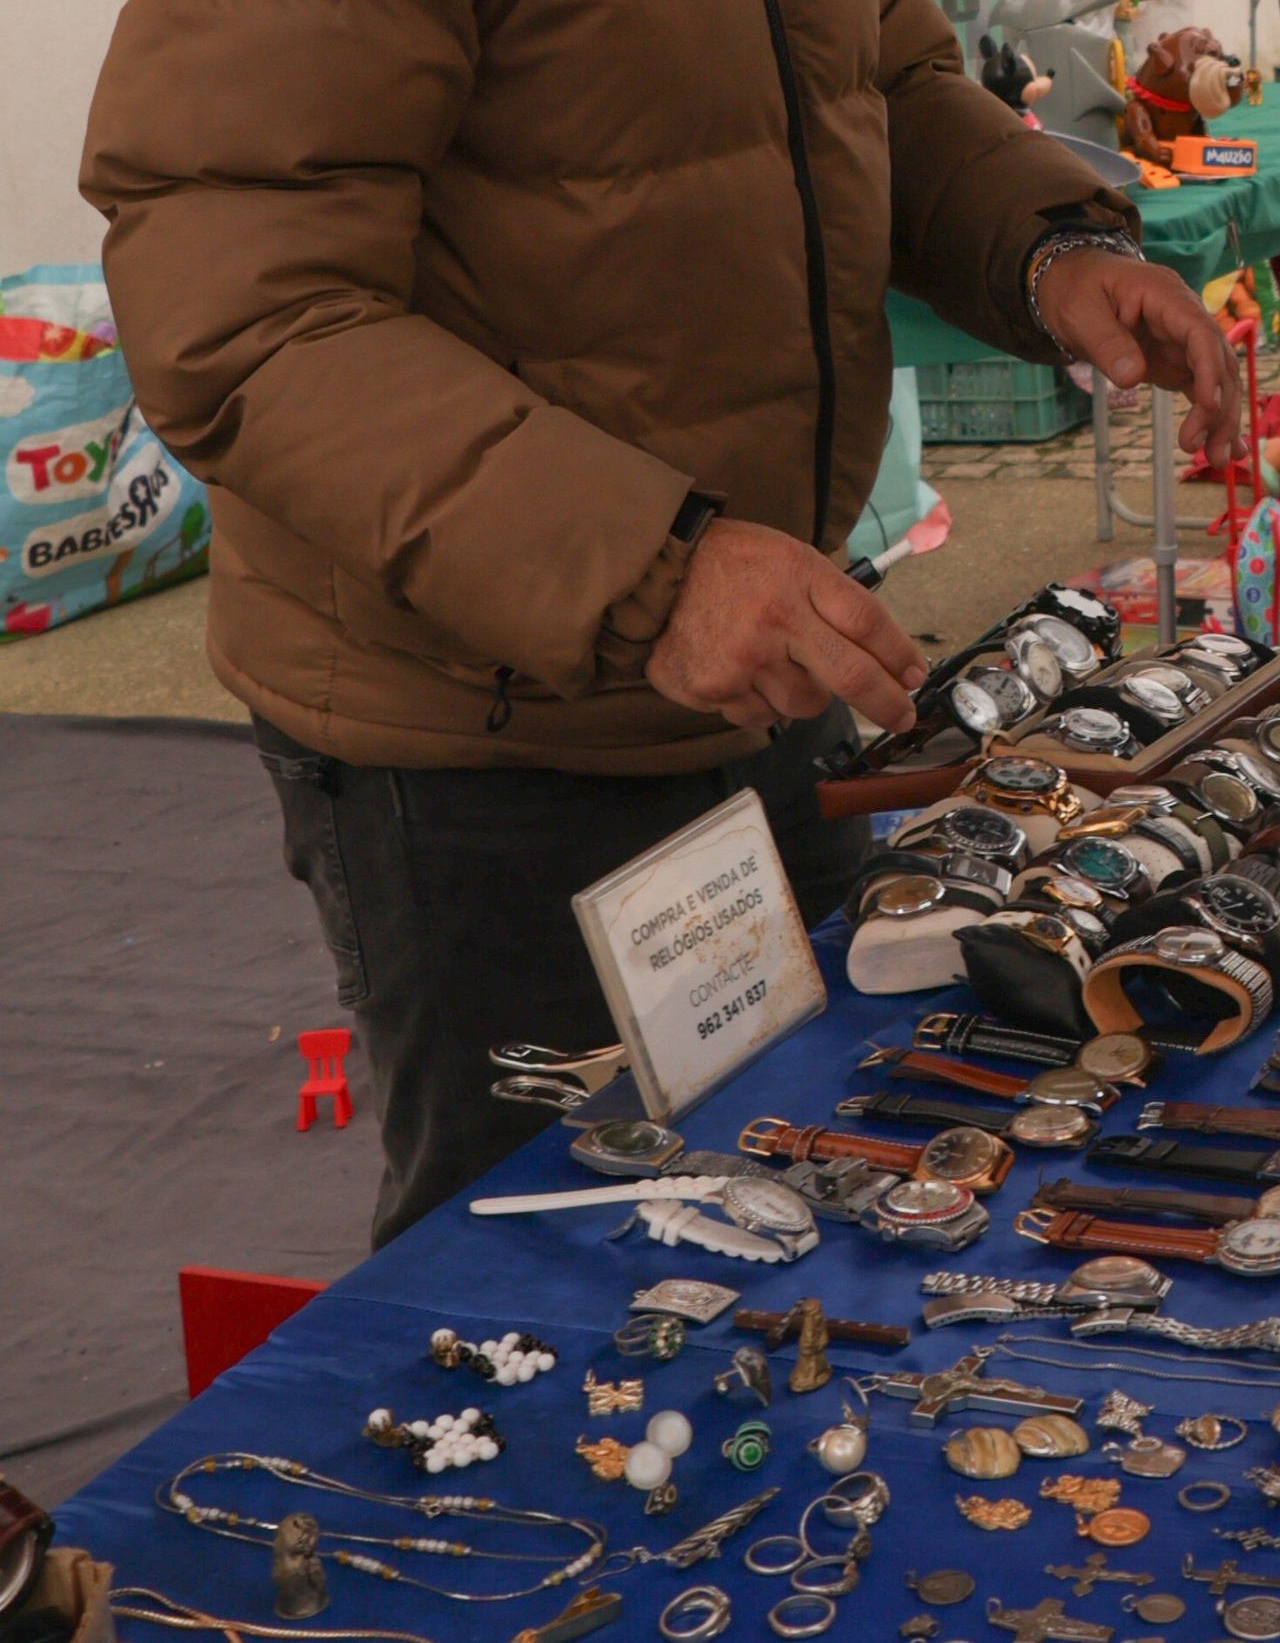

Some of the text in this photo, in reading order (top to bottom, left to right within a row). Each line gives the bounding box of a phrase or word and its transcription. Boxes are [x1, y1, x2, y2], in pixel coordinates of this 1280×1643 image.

[630, 855, 759, 946] COMPRA E VENDA DE
[650, 888, 764, 972] RELÓGIOS USADOS
[689, 952, 755, 1008] CONTACTE
[697, 979, 768, 1040] 962 341 837
